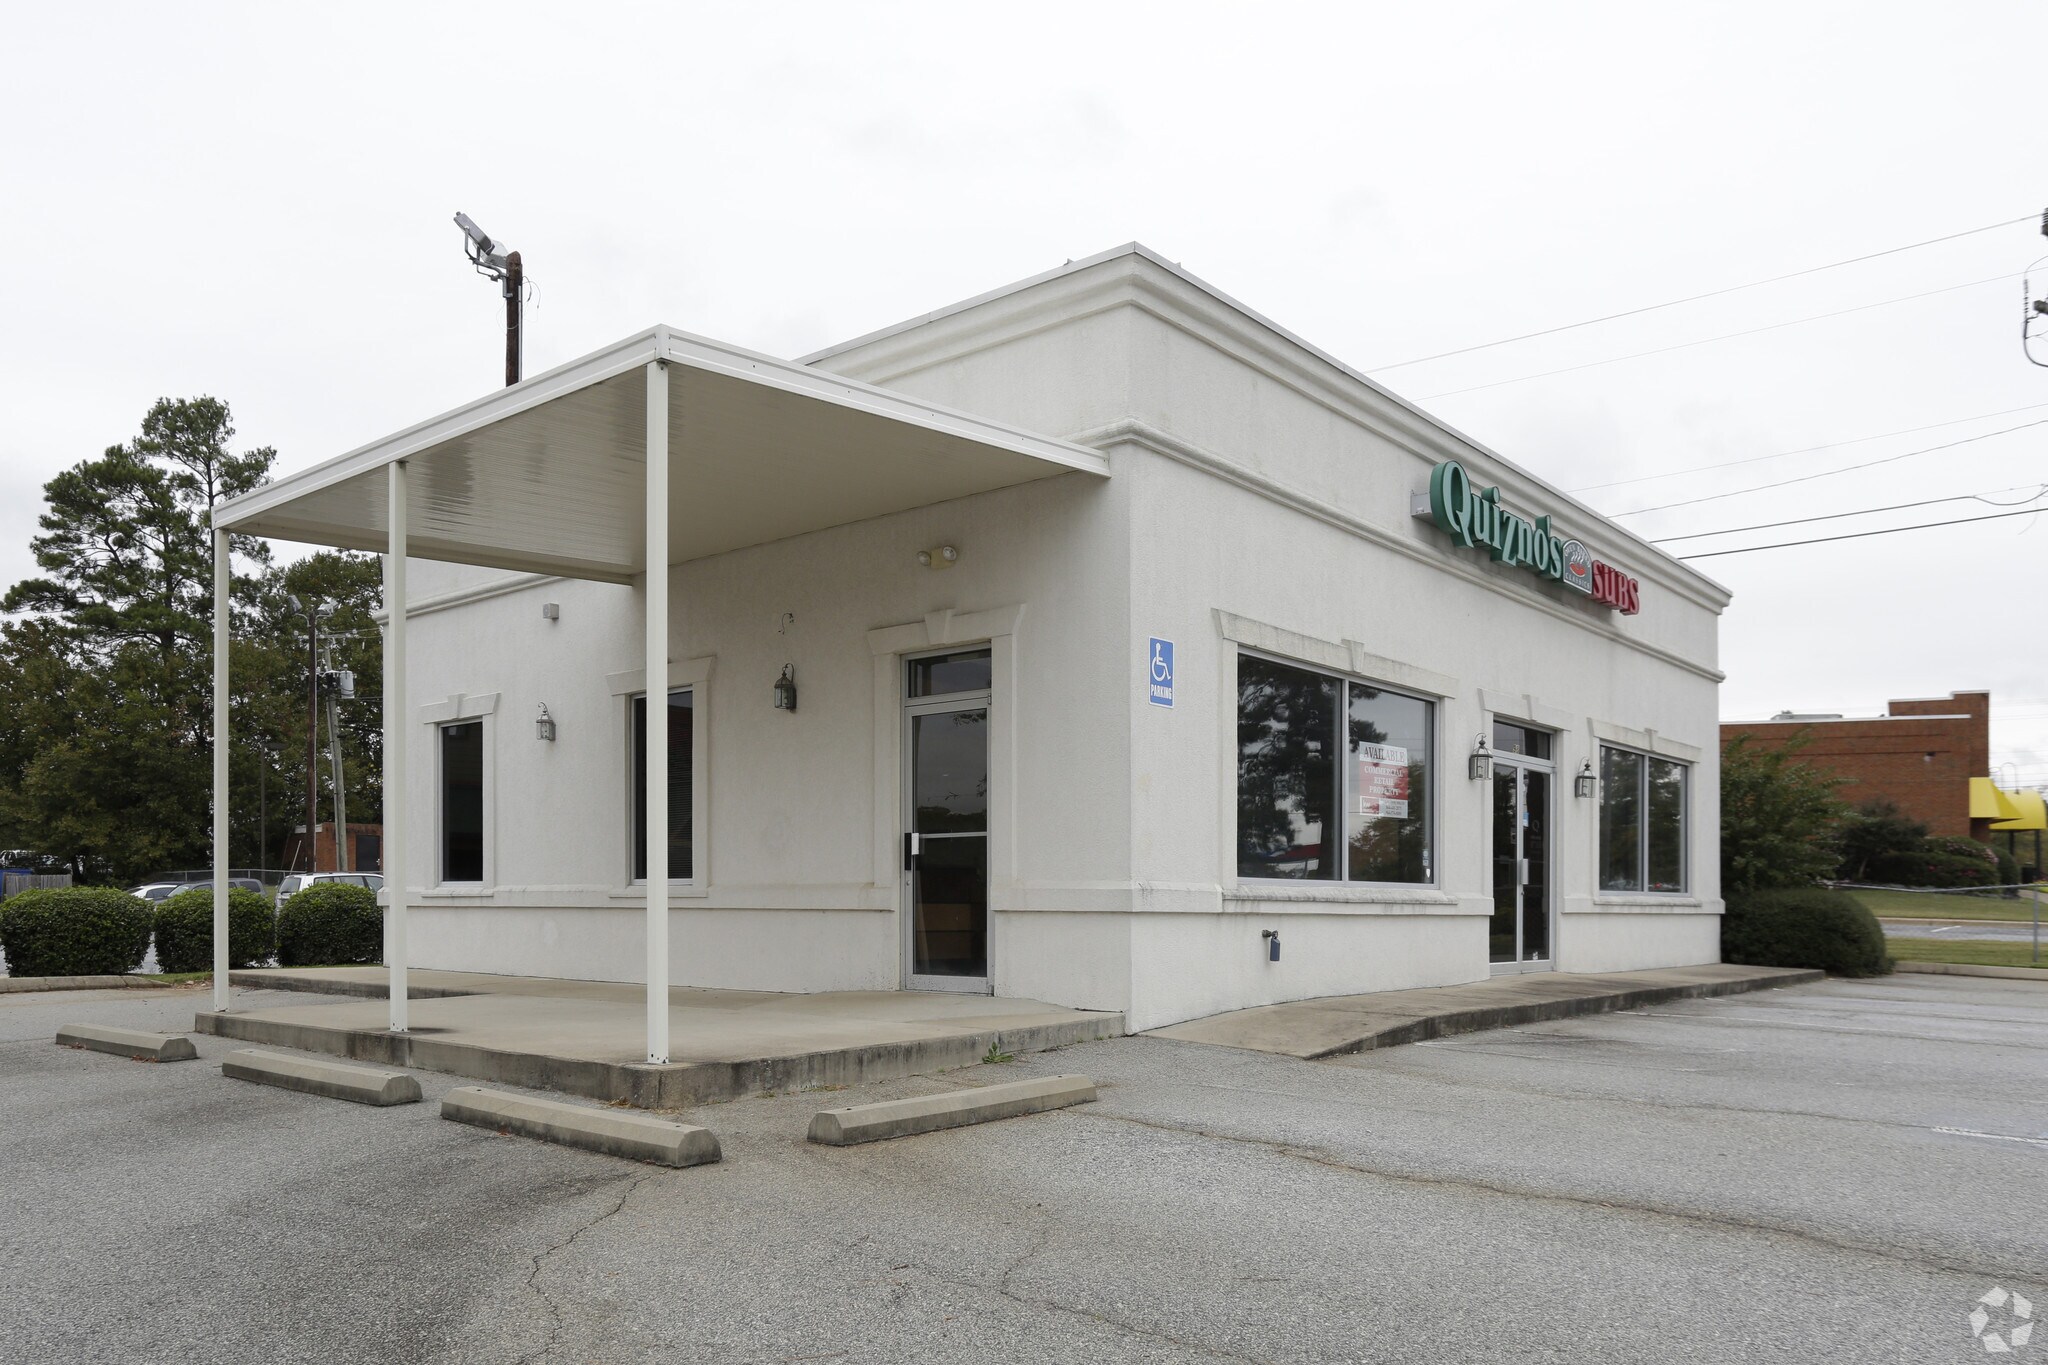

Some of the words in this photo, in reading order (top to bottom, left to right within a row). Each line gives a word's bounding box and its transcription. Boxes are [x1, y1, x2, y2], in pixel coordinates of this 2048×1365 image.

[1430, 460, 1562, 579] Quizno's
[1592, 560, 1639, 614] SUBS
[1150, 684, 1172, 700] PARKING
[1364, 746, 1405, 763] AVAILABLE
[1364, 765, 1403, 777] COMMERCIAL
[1374, 776, 1395, 786] RETAIL
